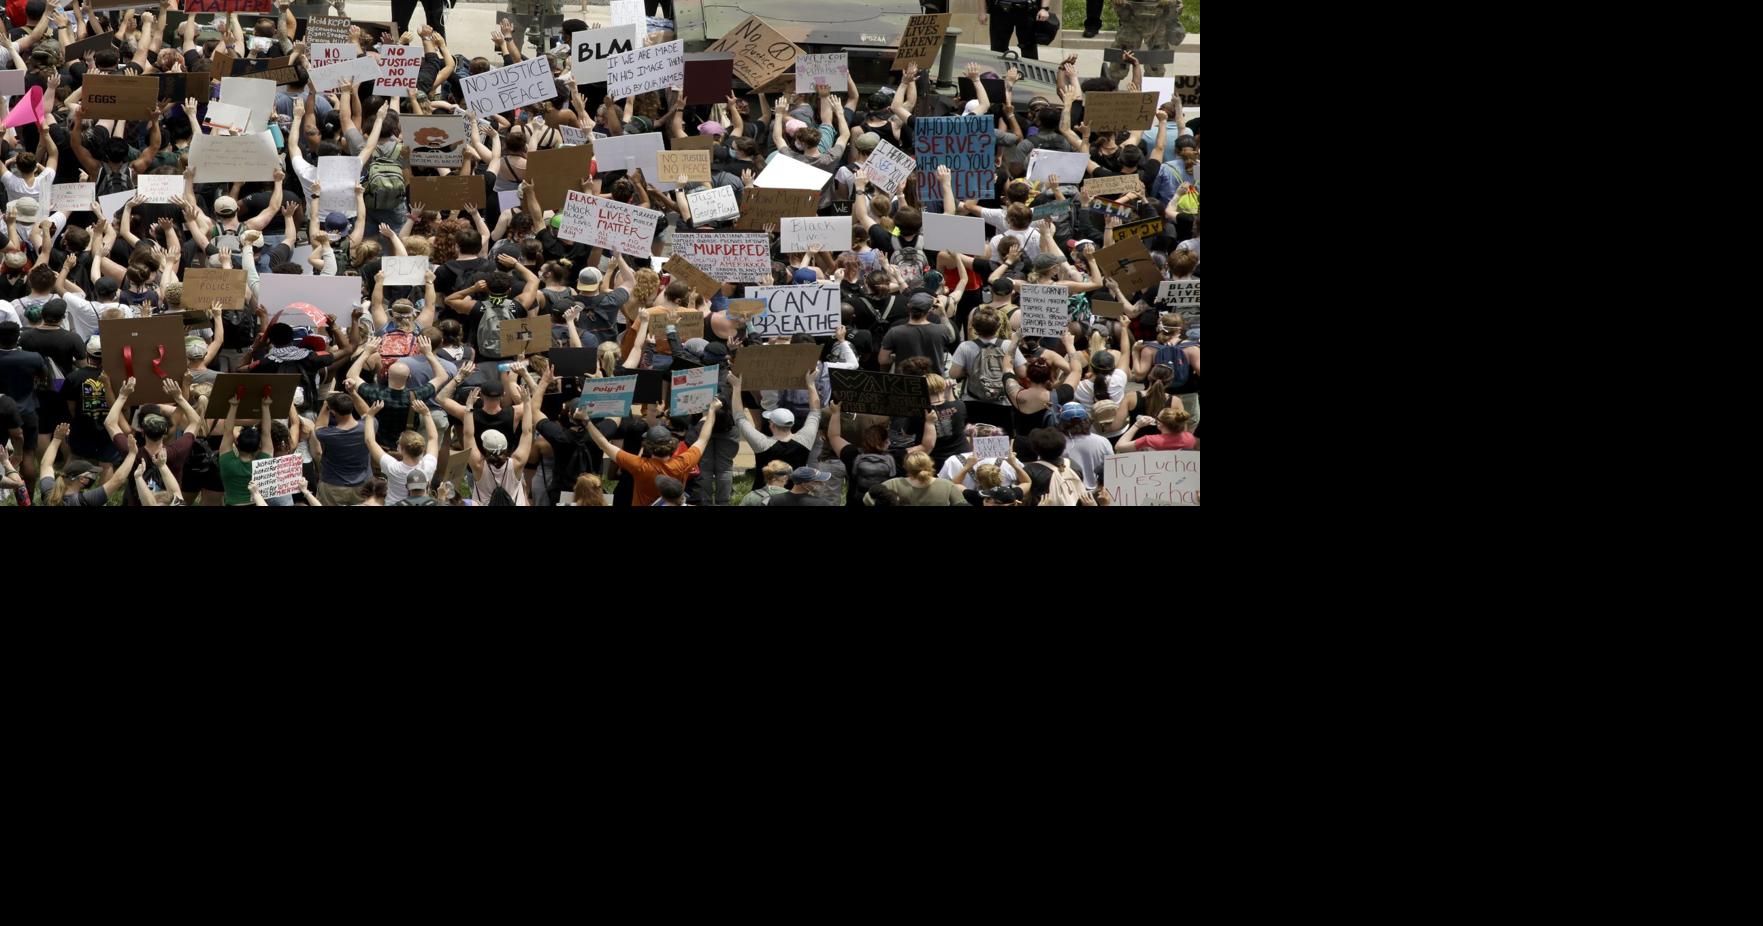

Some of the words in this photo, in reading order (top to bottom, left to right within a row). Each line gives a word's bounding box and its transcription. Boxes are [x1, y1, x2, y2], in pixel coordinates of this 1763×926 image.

[308, 15, 327, 25] Hold
[328, 18, 350, 27] KCPD
[909, 15, 938, 26] BLUE
[735, 19, 762, 42] No
[905, 25, 940, 37] LIVES
[712, 39, 738, 52] N
[901, 35, 942, 48] ARENT
[325, 47, 340, 58] NO
[387, 47, 405, 56] NO
[578, 38, 633, 62] BLM
[608, 56, 618, 69] IF
[622, 54, 635, 65] WE
[638, 49, 651, 60] ARE
[655, 43, 679, 57] MADE
[897, 47, 927, 59] REAL
[388, 68, 405, 76] NO
[465, 76, 487, 94] NO
[490, 57, 549, 86] JUSTICE
[608, 73, 618, 85] IN
[620, 70, 634, 81] HIS
[637, 61, 664, 77] IMAGE
[668, 56, 684, 67] THEN
[376, 77, 417, 88] PEACE
[621, 86, 632, 95] US
[634, 82, 645, 92] BY
[644, 80, 658, 90] OUR
[659, 72, 684, 85] NAMES
[1175, 76, 1200, 88] JU
[88, 94, 117, 104] EGGS
[470, 97, 493, 113] NO
[498, 81, 549, 108] PEACE
[916, 118, 943, 136] WHO
[947, 118, 961, 134] DO
[964, 117, 988, 133] YOU
[917, 134, 992, 155] SERVE?
[662, 153, 678, 162] NO
[682, 153, 707, 161] JUSTICE
[877, 140, 888, 154] I
[901, 157, 915, 171] YOU
[916, 156, 938, 171] WHO
[946, 155, 961, 170] DO
[966, 153, 990, 170] YOU
[663, 164, 679, 174] NO
[682, 164, 707, 173] PEACE
[867, 153, 878, 164] I
[889, 166, 905, 182] YOU
[883, 179, 897, 193] YOU
[569, 192, 597, 206] BLACK
[691, 187, 733, 203] JUSTICE
[567, 203, 592, 217] black
[693, 206, 717, 219] George
[717, 202, 737, 214] Floyd
[833, 203, 849, 213] WE
[1093, 199, 1132, 218] BLM
[598, 209, 631, 225] LIVES
[597, 220, 648, 239] MATTER
[790, 219, 835, 233] Black
[1117, 222, 1160, 240] ACAB
[693, 243, 765, 256] MURDERED
[200, 282, 230, 290] POLICE
[1022, 285, 1039, 294] ERIC
[198, 296, 233, 304] VIOLENCE
[768, 285, 840, 314] CAN'T
[752, 313, 840, 334] BREATHE
[592, 385, 626, 393] Poly-fil
[832, 370, 922, 395] WAKE
[1142, 454, 1197, 475] Lucha
[1136, 475, 1162, 486] ES
